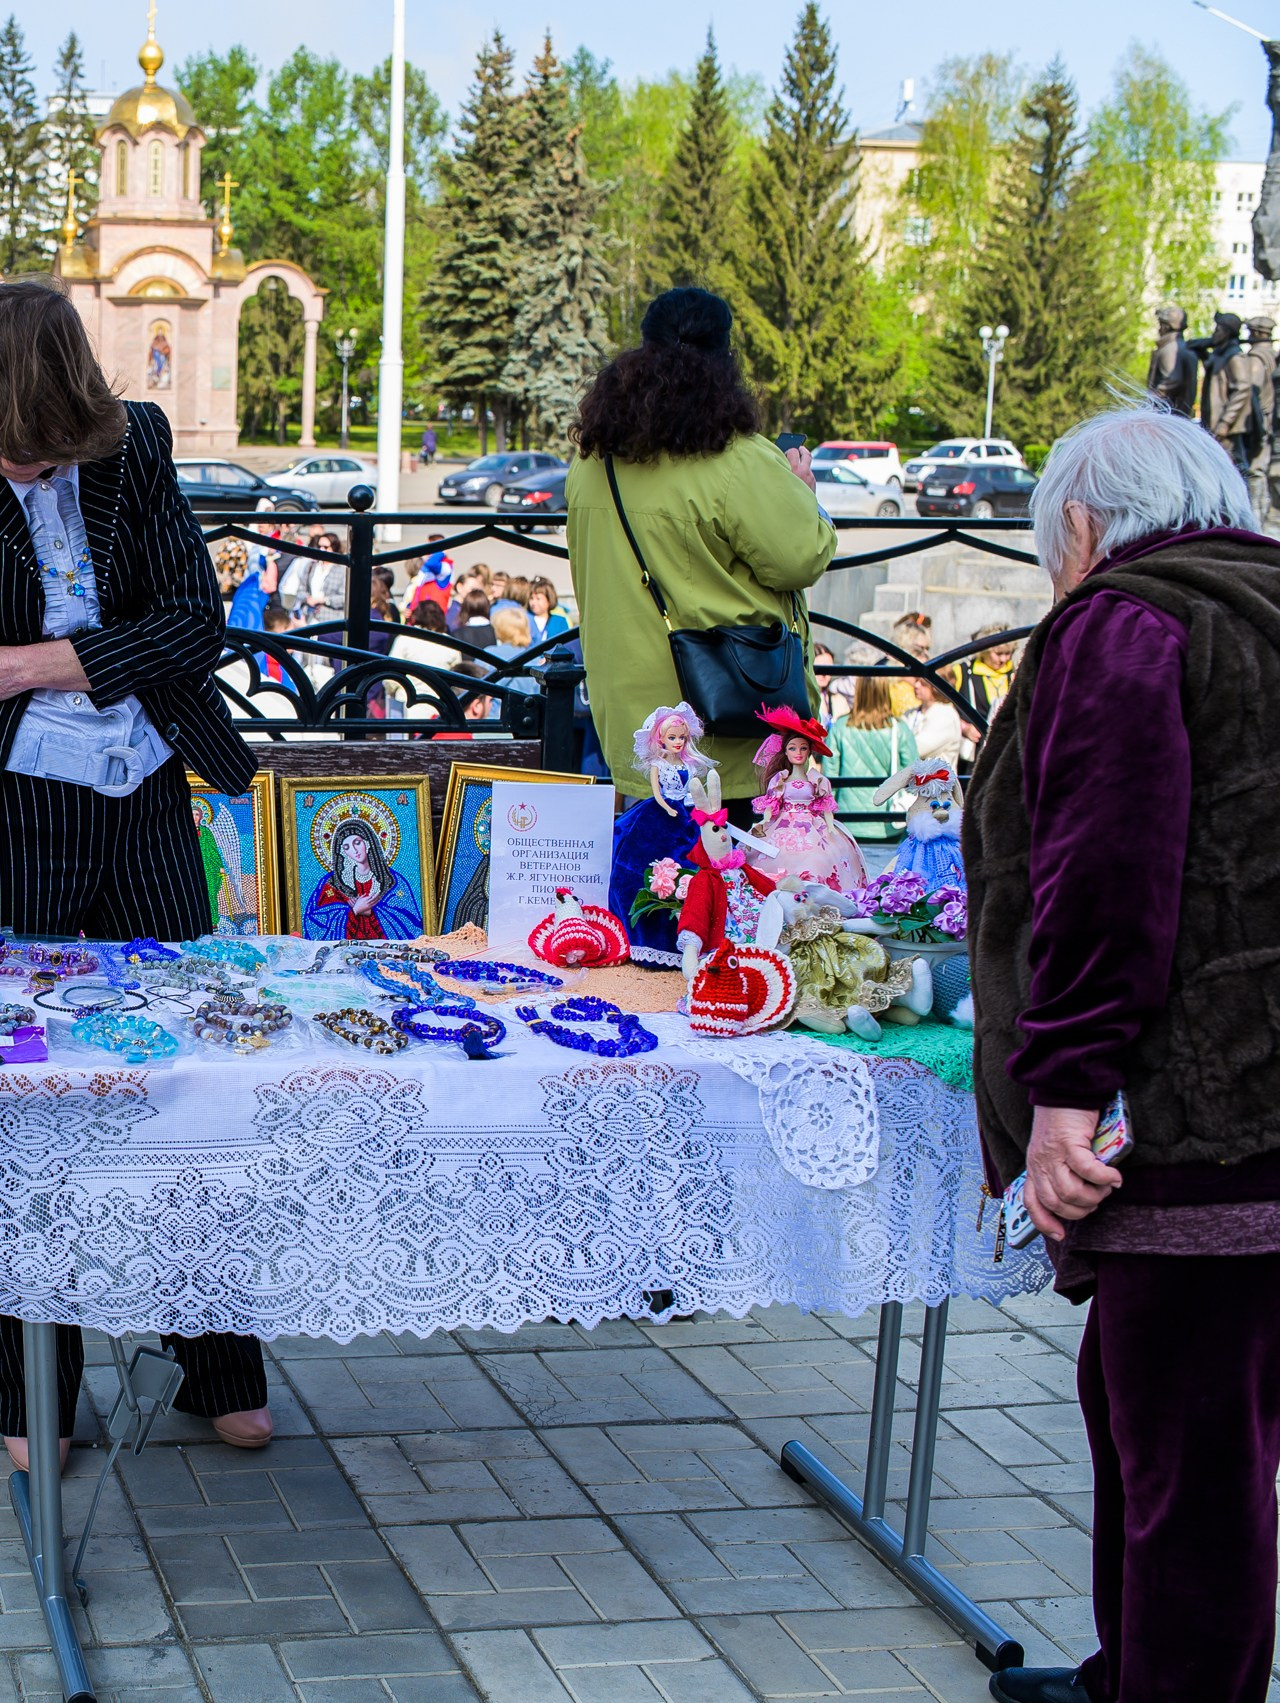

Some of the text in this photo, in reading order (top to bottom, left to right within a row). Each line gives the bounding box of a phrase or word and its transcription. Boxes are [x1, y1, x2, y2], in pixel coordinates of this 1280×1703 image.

[507, 837, 594, 849] ОБЩЕСТВЕННАЯ
[512, 849, 589, 861] ОРГАНИЗАЦИЯ
[519, 861, 581, 871] ВЕТЕРАНОВ
[506, 872, 604, 885] Ж.Р. ЯГУНОВСКИЙ,
